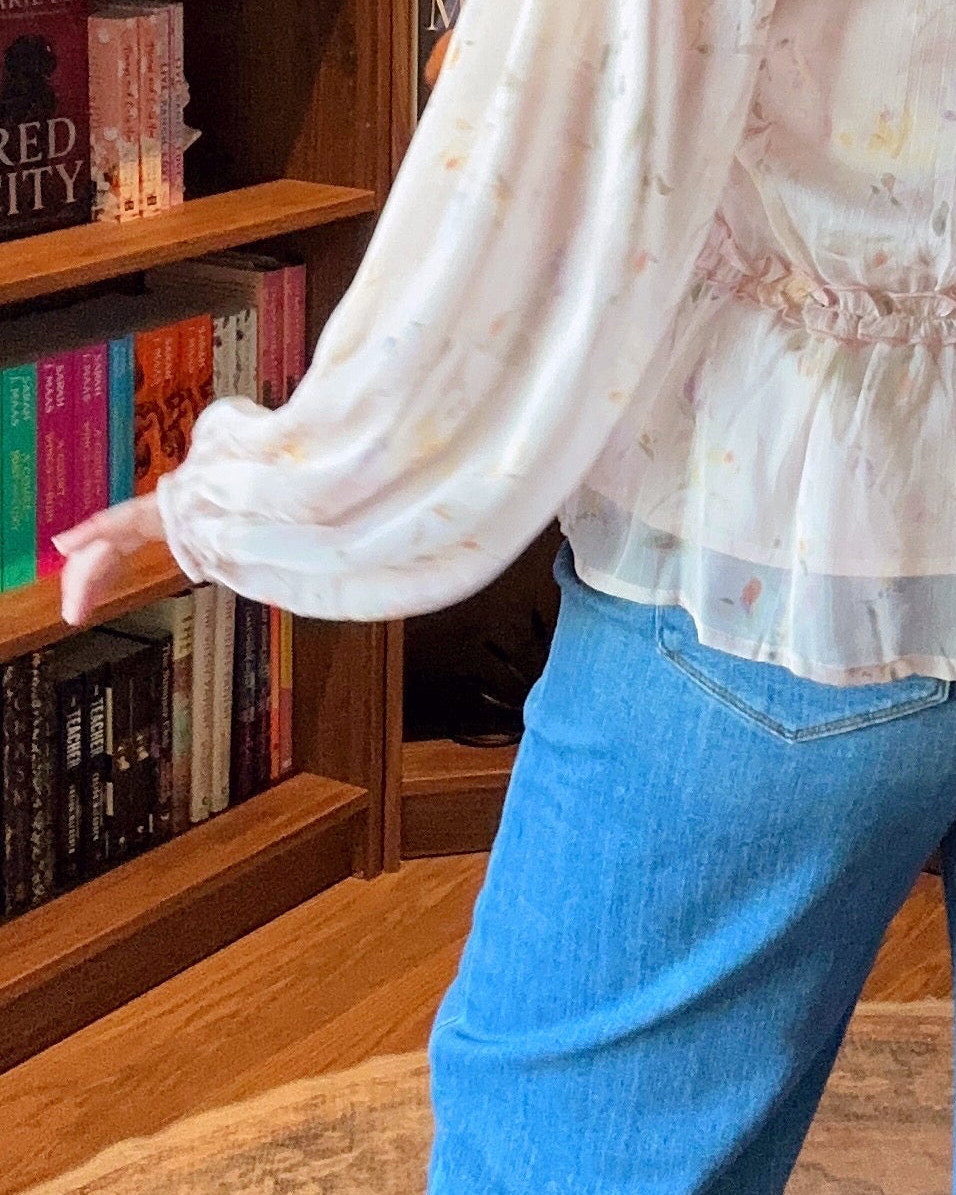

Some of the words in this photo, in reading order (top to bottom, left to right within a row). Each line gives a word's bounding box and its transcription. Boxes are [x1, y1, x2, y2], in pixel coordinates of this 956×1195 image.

[0, 159, 83, 216] ITY
[65, 710, 82, 770] TEACHER
[88, 697, 104, 757] TEACHER
